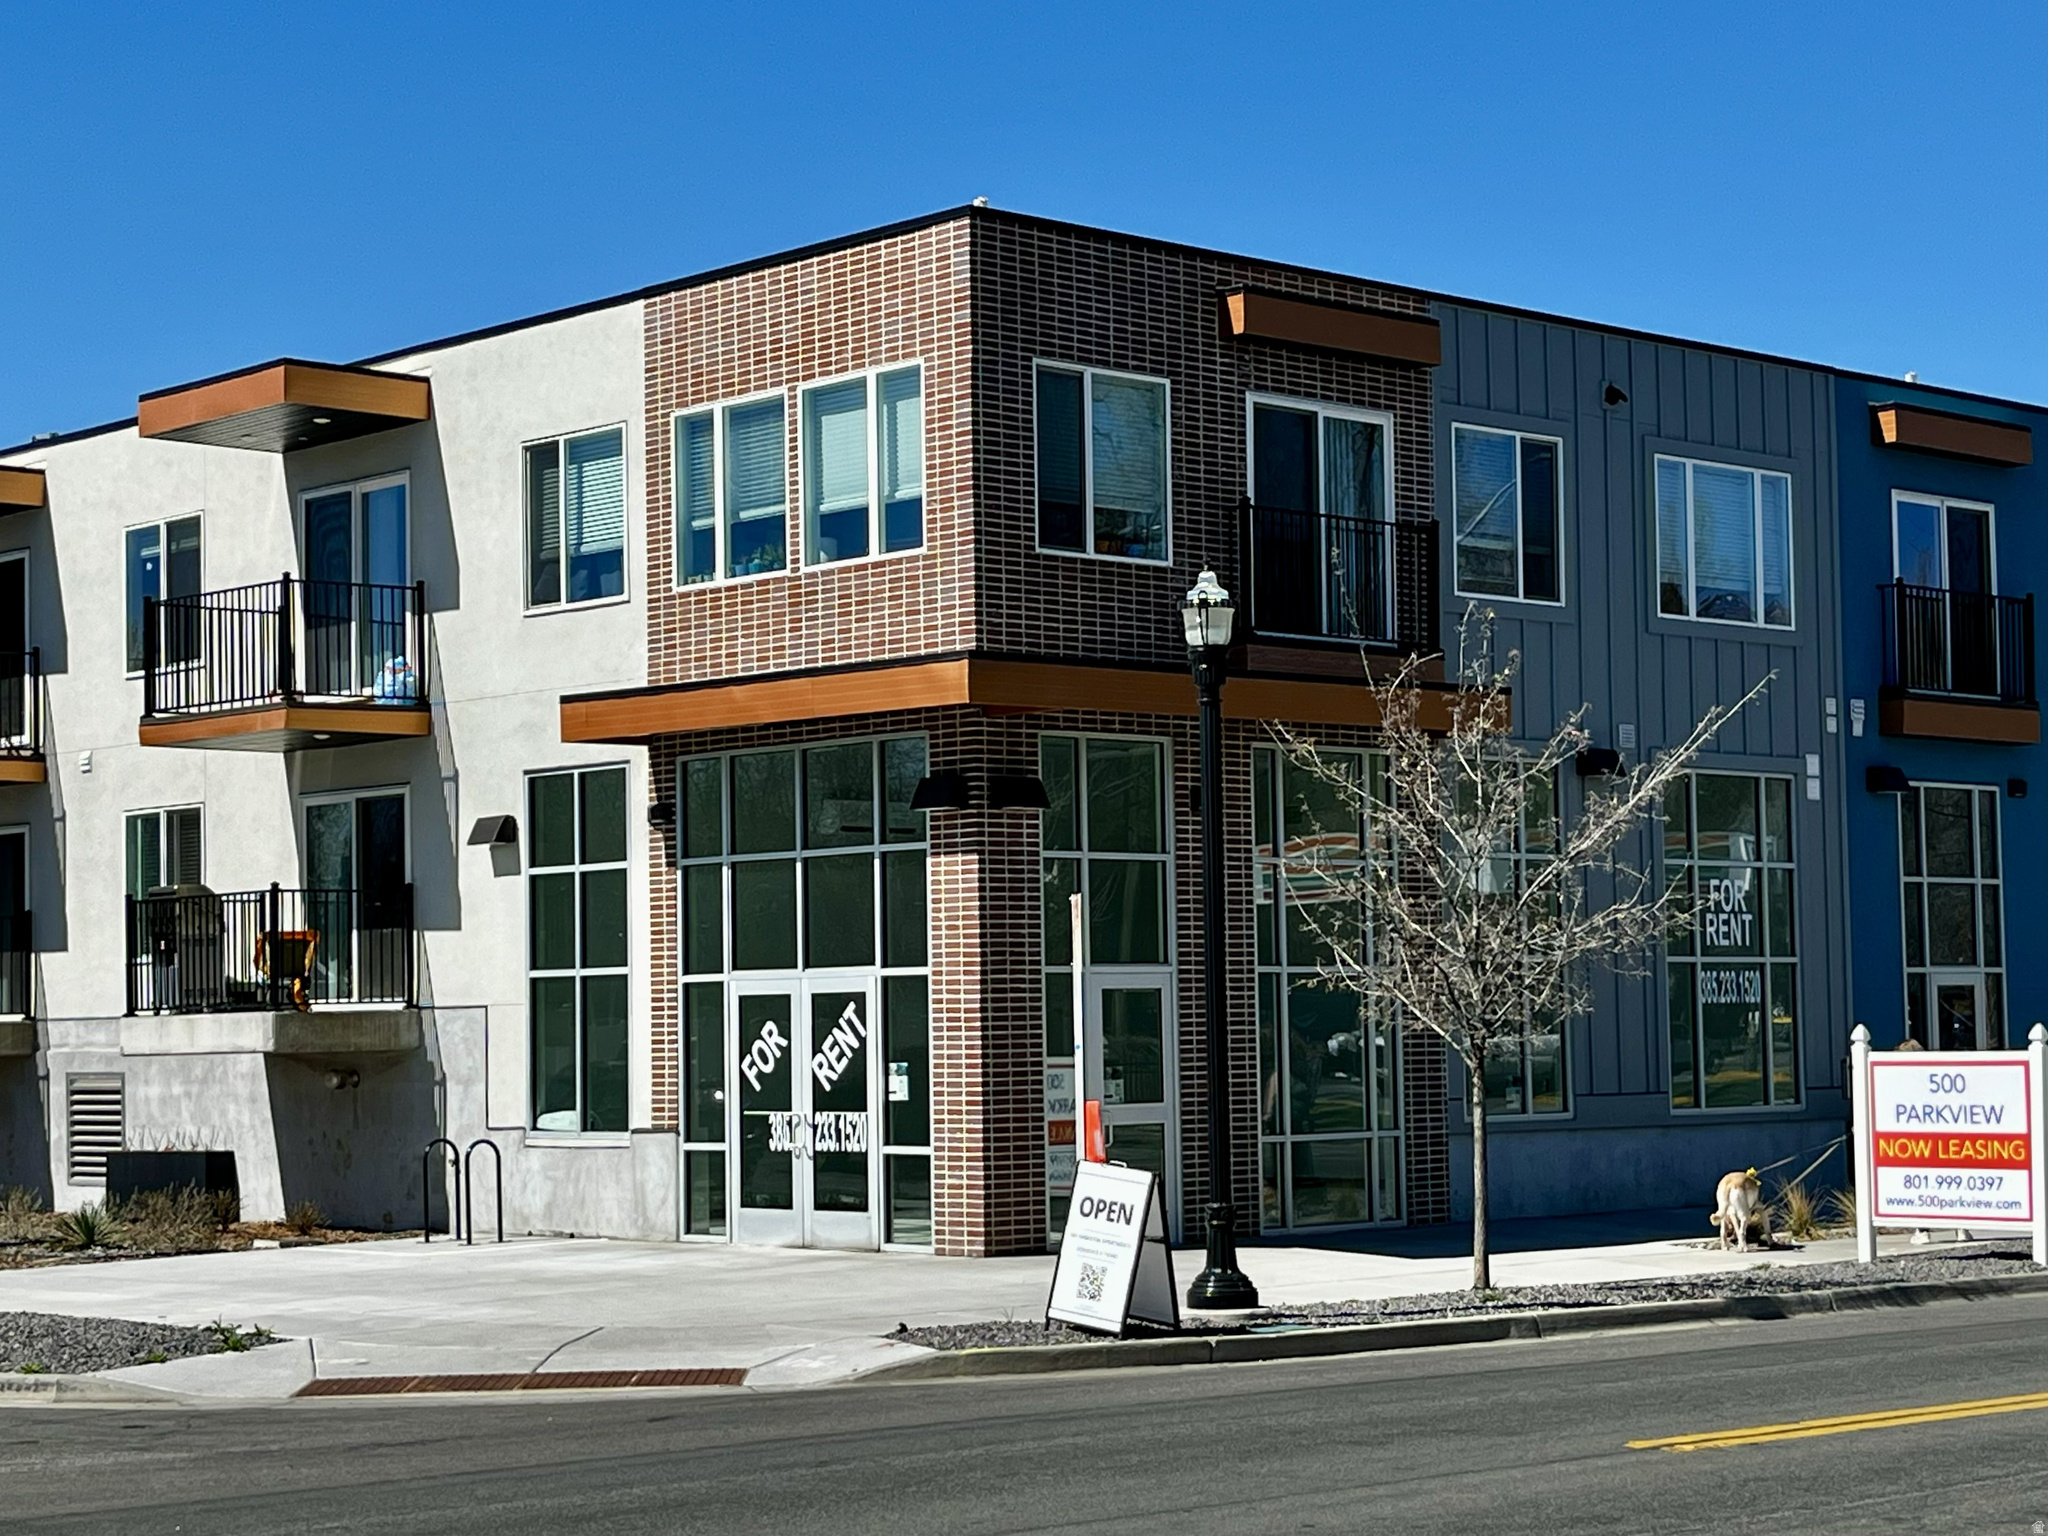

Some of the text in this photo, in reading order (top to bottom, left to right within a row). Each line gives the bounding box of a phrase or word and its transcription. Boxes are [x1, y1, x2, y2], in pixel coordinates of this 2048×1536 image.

[1709, 879, 1747, 912] FOR
[1706, 913, 1752, 946] RENT
[741, 1001, 868, 1092] FOR RENT
[1929, 1073, 1966, 1093] 500
[1896, 1104, 2004, 1124] PARKVIEW
[1878, 1138, 2026, 1160] NOW LEASING
[1903, 1174, 2004, 1191] 801.999.0397
[1079, 1196, 1135, 1226] OPEN
[1886, 1195, 2022, 1210] www.500parkview.com
